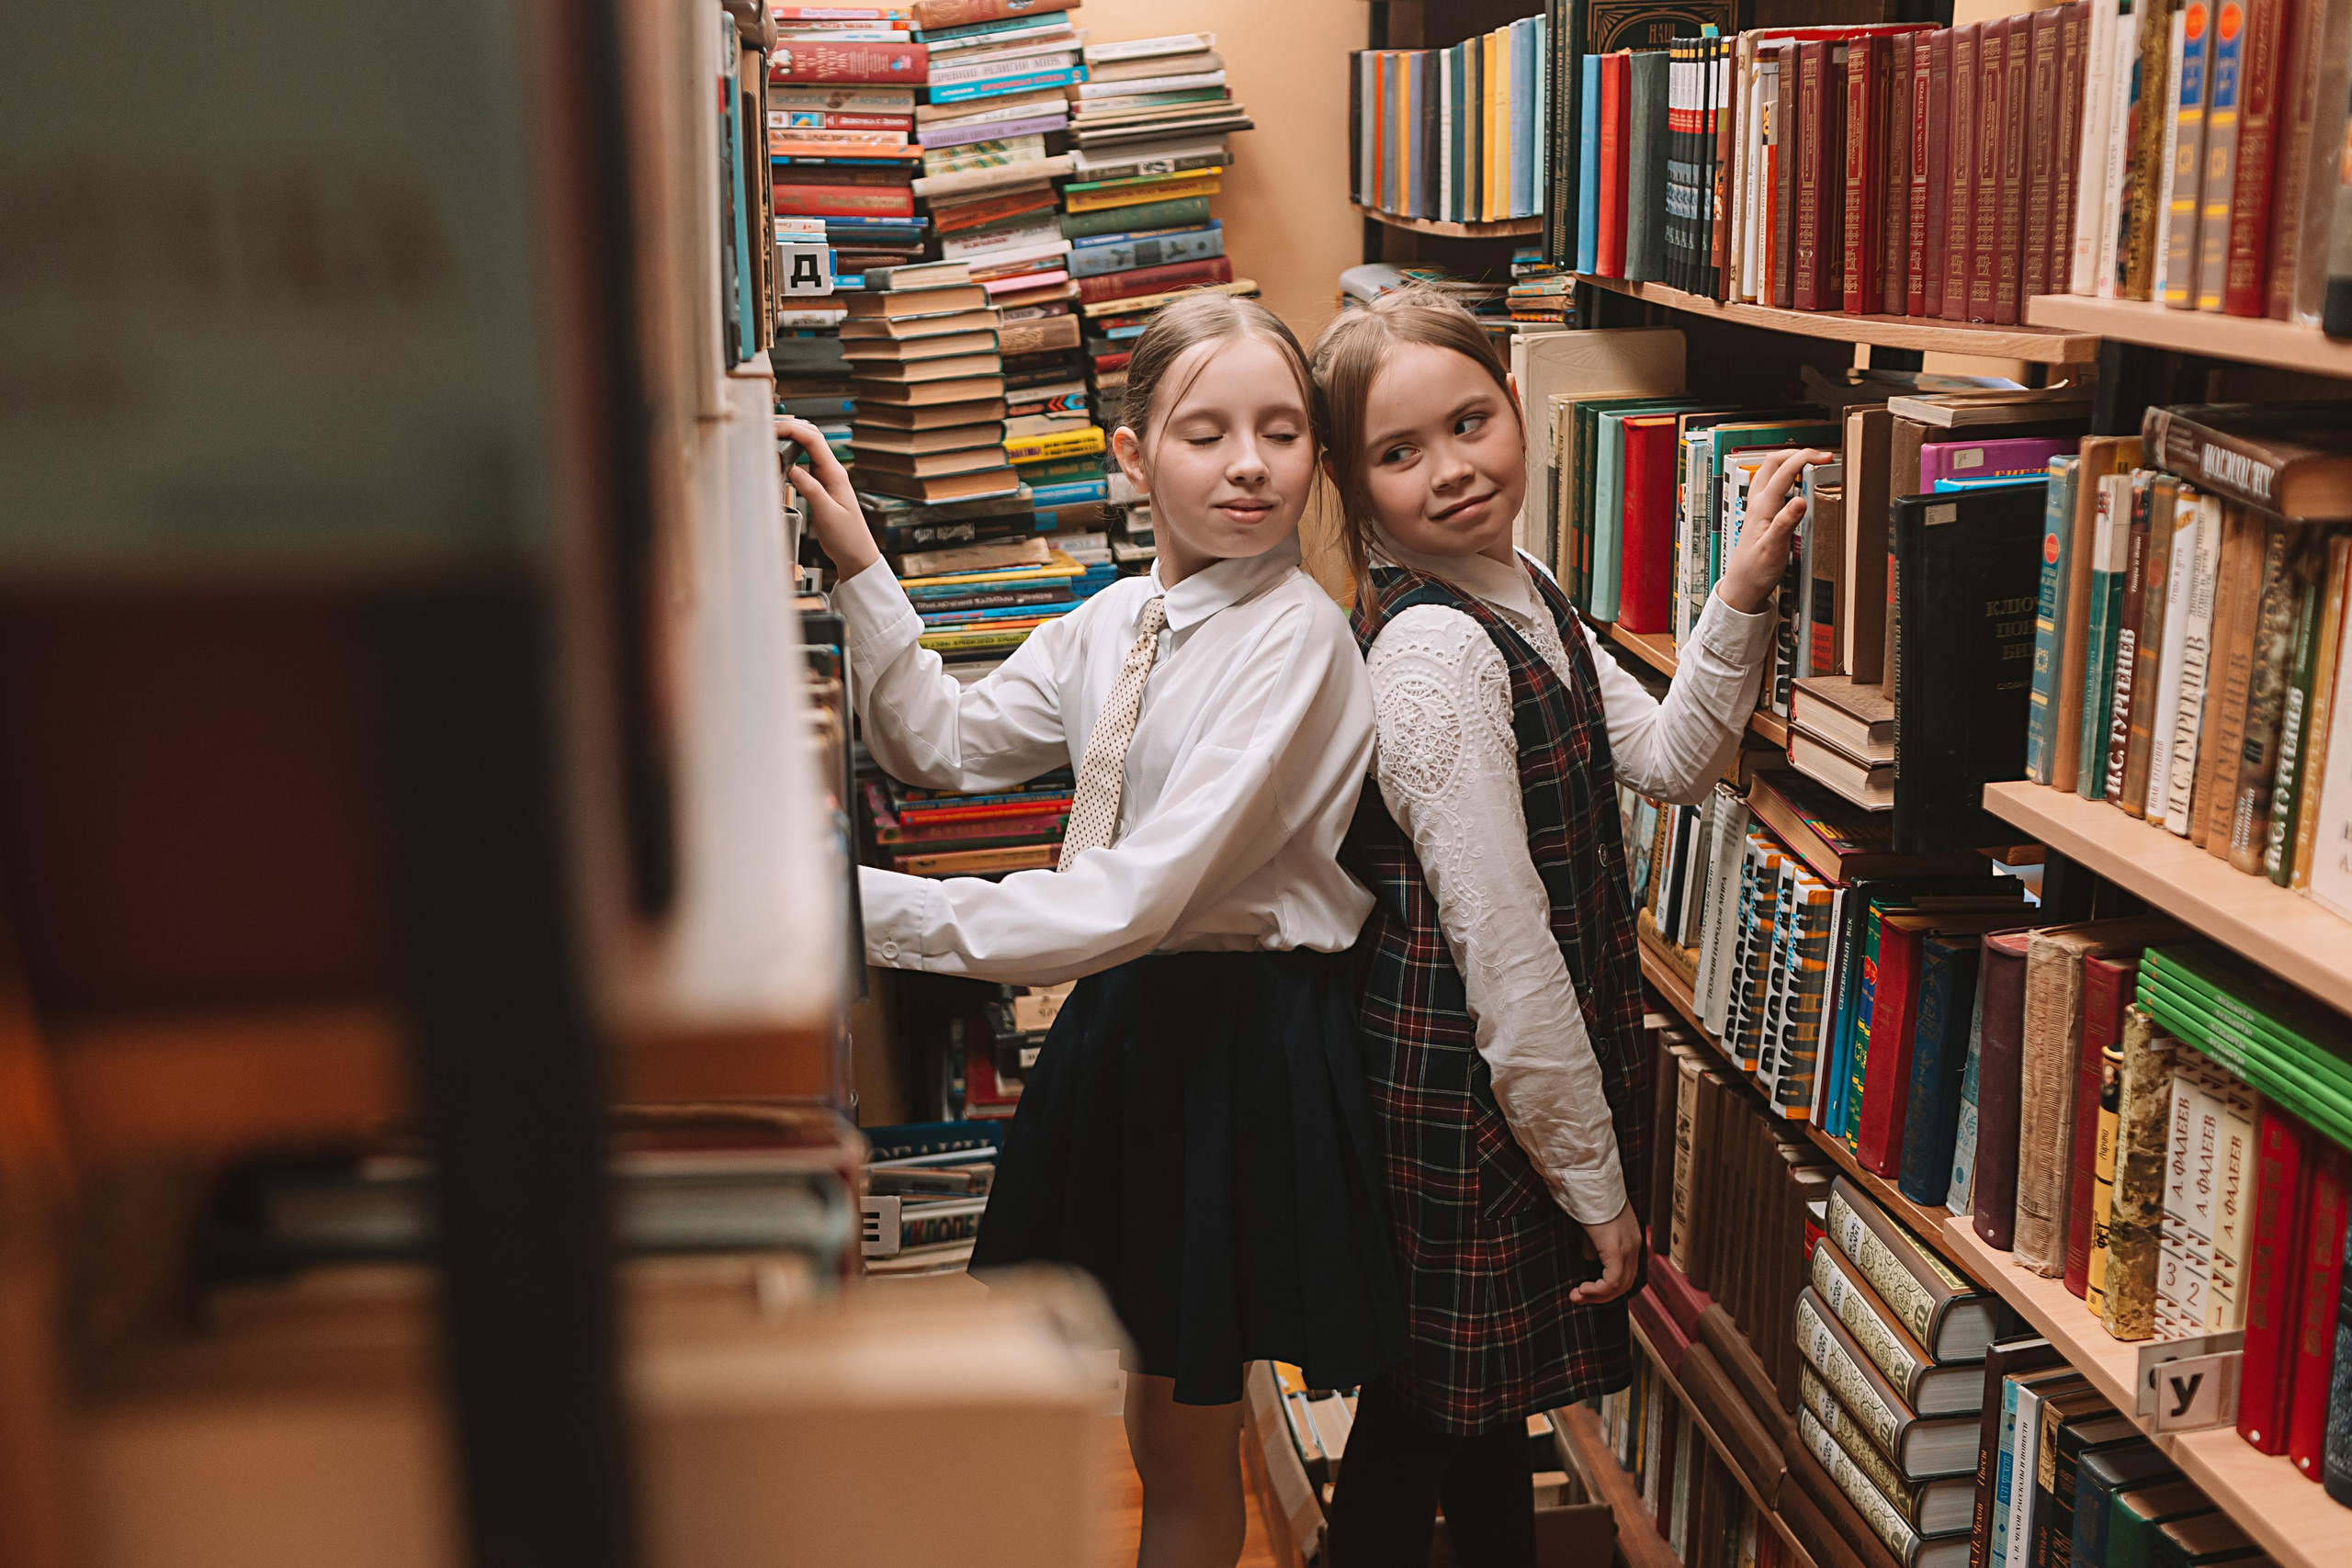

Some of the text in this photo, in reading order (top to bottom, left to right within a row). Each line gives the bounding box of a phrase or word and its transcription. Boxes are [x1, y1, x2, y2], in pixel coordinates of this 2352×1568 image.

[933, 56, 1061, 83] ДРЕВНИЕ РЕЛИГИИ МИРА
[2108, 143, 2118, 188] КАЗАКИ
[790, 254, 822, 288] Д
[2204, 442, 2252, 491] ТОЛСТОЙ
[2175, 547, 2188, 569] дети
[917, 598, 973, 609] ПРИКЛЮЧЕНИЯ
[974, 595, 1014, 605] КАПИТАНА
[2169, 580, 2180, 604] Отцы
[1996, 619, 2038, 638] ПОН
[2111, 628, 2135, 744] ТУРГЕНЕВ
[2172, 635, 2206, 764] ТУРГЕНЕВ
[2214, 651, 2248, 784] ТУРГЕНЕВ
[2152, 739, 2165, 784] ТУРГЕНЕВ
[2274, 686, 2304, 814] ТУРГЕНЕВ
[2149, 785, 2160, 809] ИВАН
[1655, 826, 1665, 880] ВЕЛИКИХ
[1707, 876, 1727, 998] ПОЭЗИЯ НАРОДОВ МИРА
[1735, 864, 1780, 1059] РУССКАЯ
[1838, 917, 1854, 1011] СЕРЕБРЯНЫЙ ВЕК
[1775, 902, 1835, 1107] РУССКАЯ
[2172, 1097, 2190, 1201] А. ФАДЕЕВ
[2196, 1113, 2216, 1220] А. ФАДЕЕВ
[2097, 1128, 2110, 1249] ФЕТ Лирика
[2223, 1134, 2242, 1241] А. ФАДЕЕВ
[2165, 1261, 2177, 1288] 3
[2186, 1281, 2200, 1308] 2
[2215, 1305, 2223, 1329] 1
[2169, 1372, 2204, 1417] У
[2020, 1421, 2029, 1461] ПОВЕСТИ
[1977, 1450, 1988, 1486] Пьесы
[2017, 1469, 2025, 1512] РАССКАЗЫ
[1973, 1502, 1984, 1535] Чехов
[2013, 1553, 2019, 1562] А.
